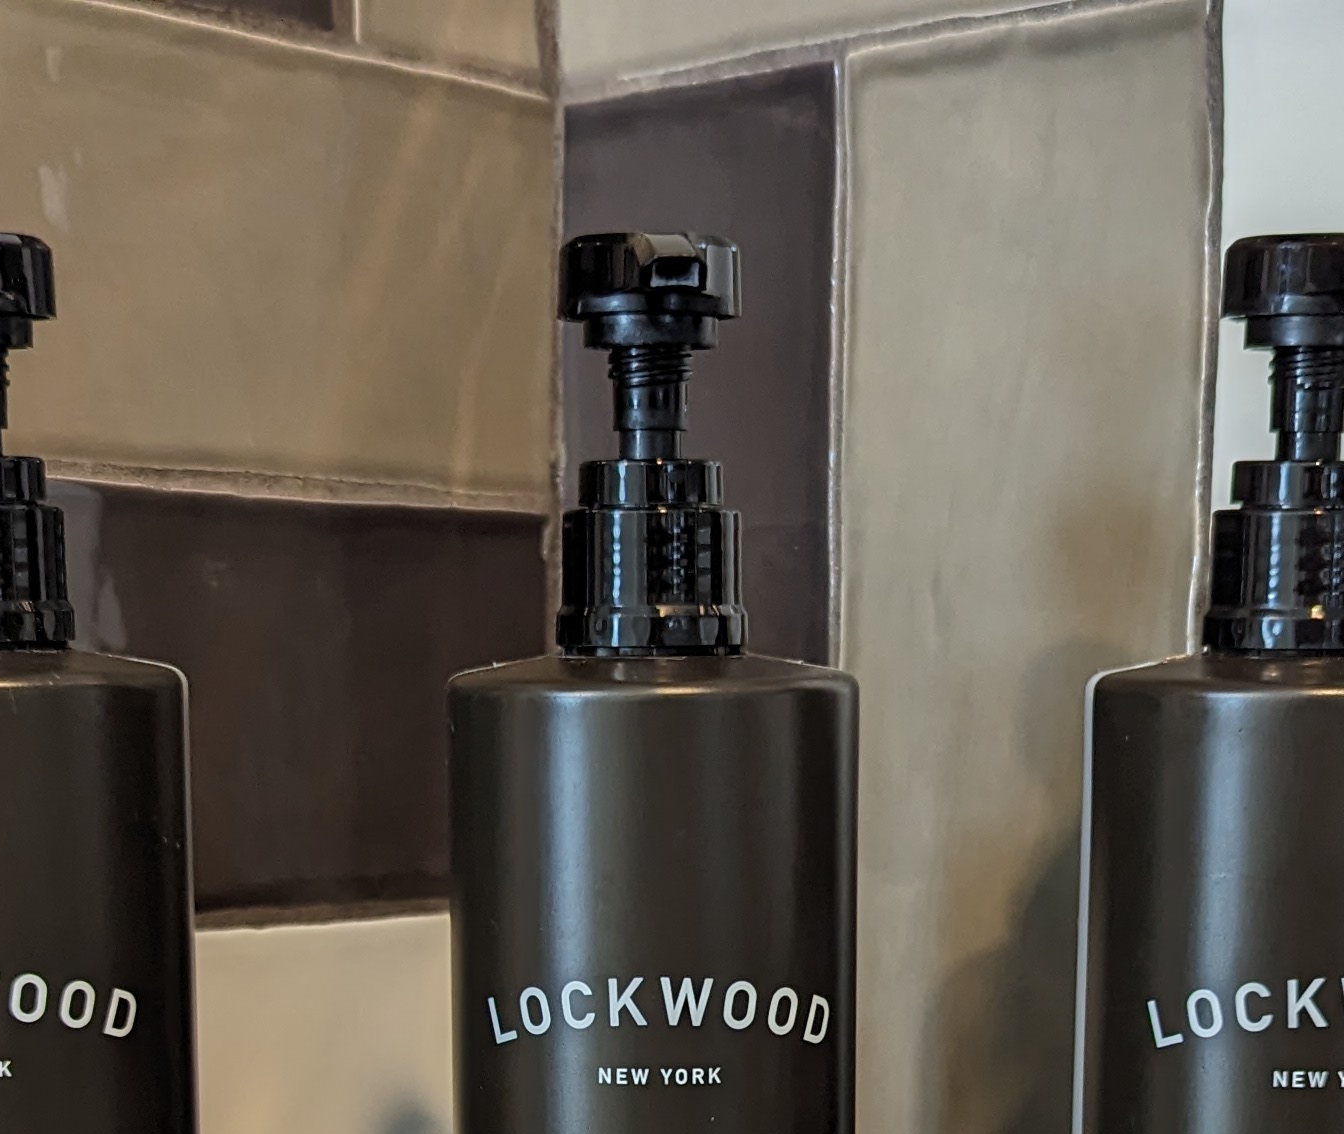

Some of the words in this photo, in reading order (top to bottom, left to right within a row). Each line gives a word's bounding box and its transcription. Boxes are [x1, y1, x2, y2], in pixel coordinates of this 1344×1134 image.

[487, 976, 831, 1045] LOCKWOOD
[598, 1067, 650, 1086] NEW
[660, 1066, 722, 1086] YORK
[1272, 1069, 1330, 1089] NEW
